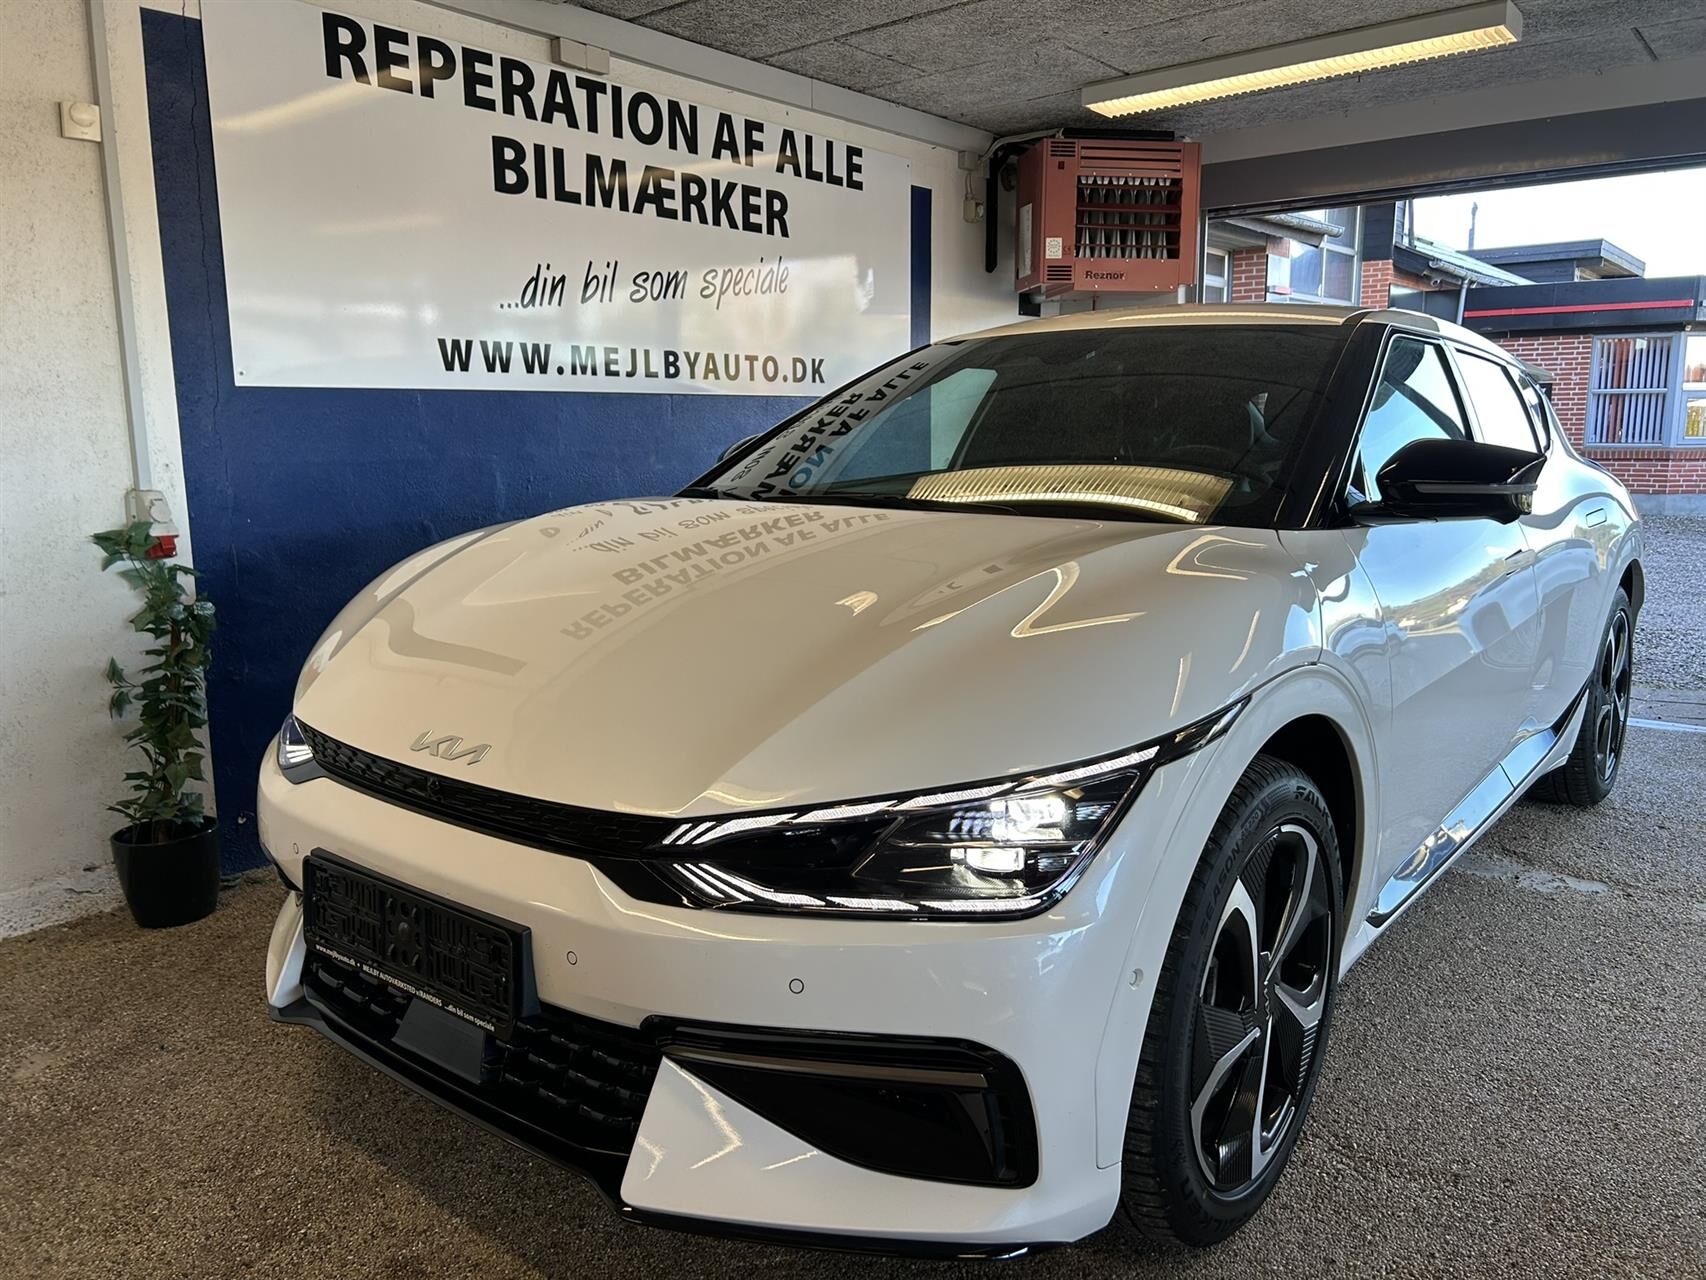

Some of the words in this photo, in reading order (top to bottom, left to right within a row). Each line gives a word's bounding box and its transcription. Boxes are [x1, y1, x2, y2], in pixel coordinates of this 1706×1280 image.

[321, 12, 699, 155] REPERATION
[712, 112, 765, 167] AF
[776, 129, 864, 191] ALLE
[492, 135, 790, 238] BILMÆRKER
[580, 259, 619, 305] bil
[630, 269, 687, 303] som
[700, 255, 789, 310] speciale
[1084, 270, 1125, 281] Reznor
[437, 337, 825, 384] WWW.MEJLBYAUTO.DK
[409, 729, 492, 766] KIA
